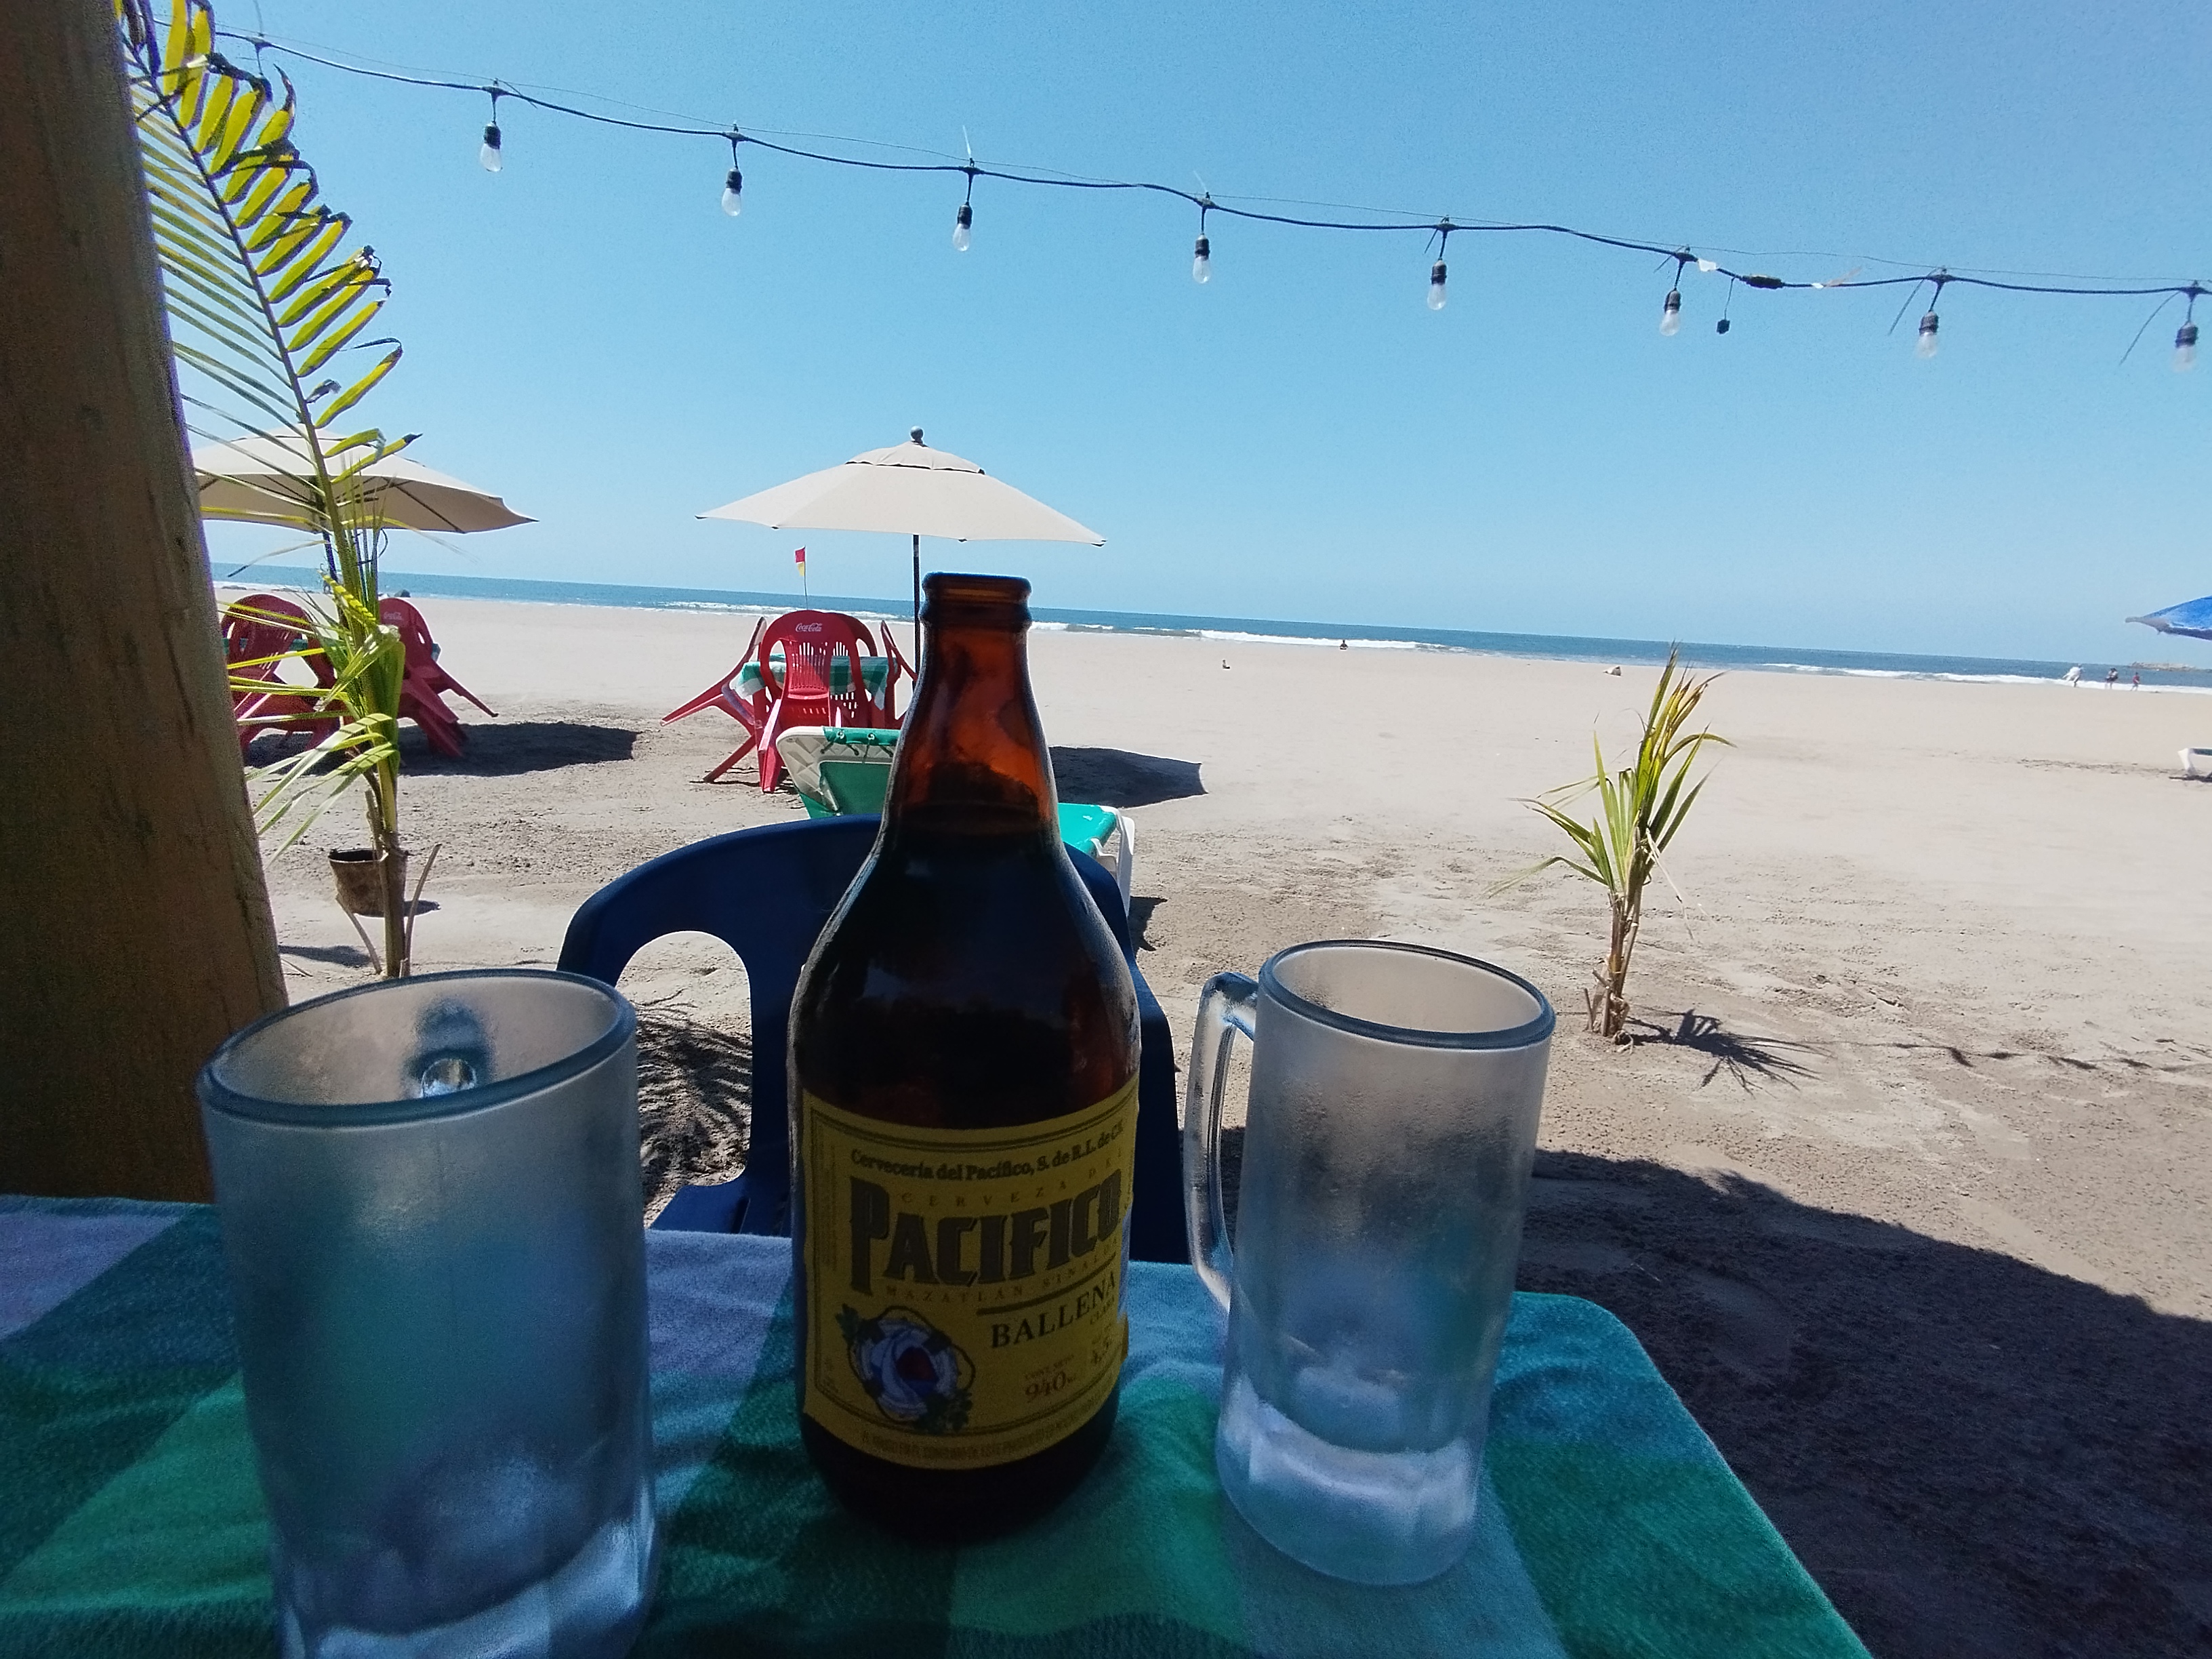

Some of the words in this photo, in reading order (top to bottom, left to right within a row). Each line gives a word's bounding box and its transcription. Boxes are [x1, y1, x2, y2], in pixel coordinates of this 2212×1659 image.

[902, 1180, 1067, 1207] CERVEZA
[1088, 1147, 1122, 1179] DEL
[937, 1162, 962, 1181] del
[1052, 1149, 1069, 1168] de
[1097, 1131, 1109, 1149] de
[850, 1168, 1122, 1296] PACIFICO
[991, 1271, 1115, 1349] BALLENA
